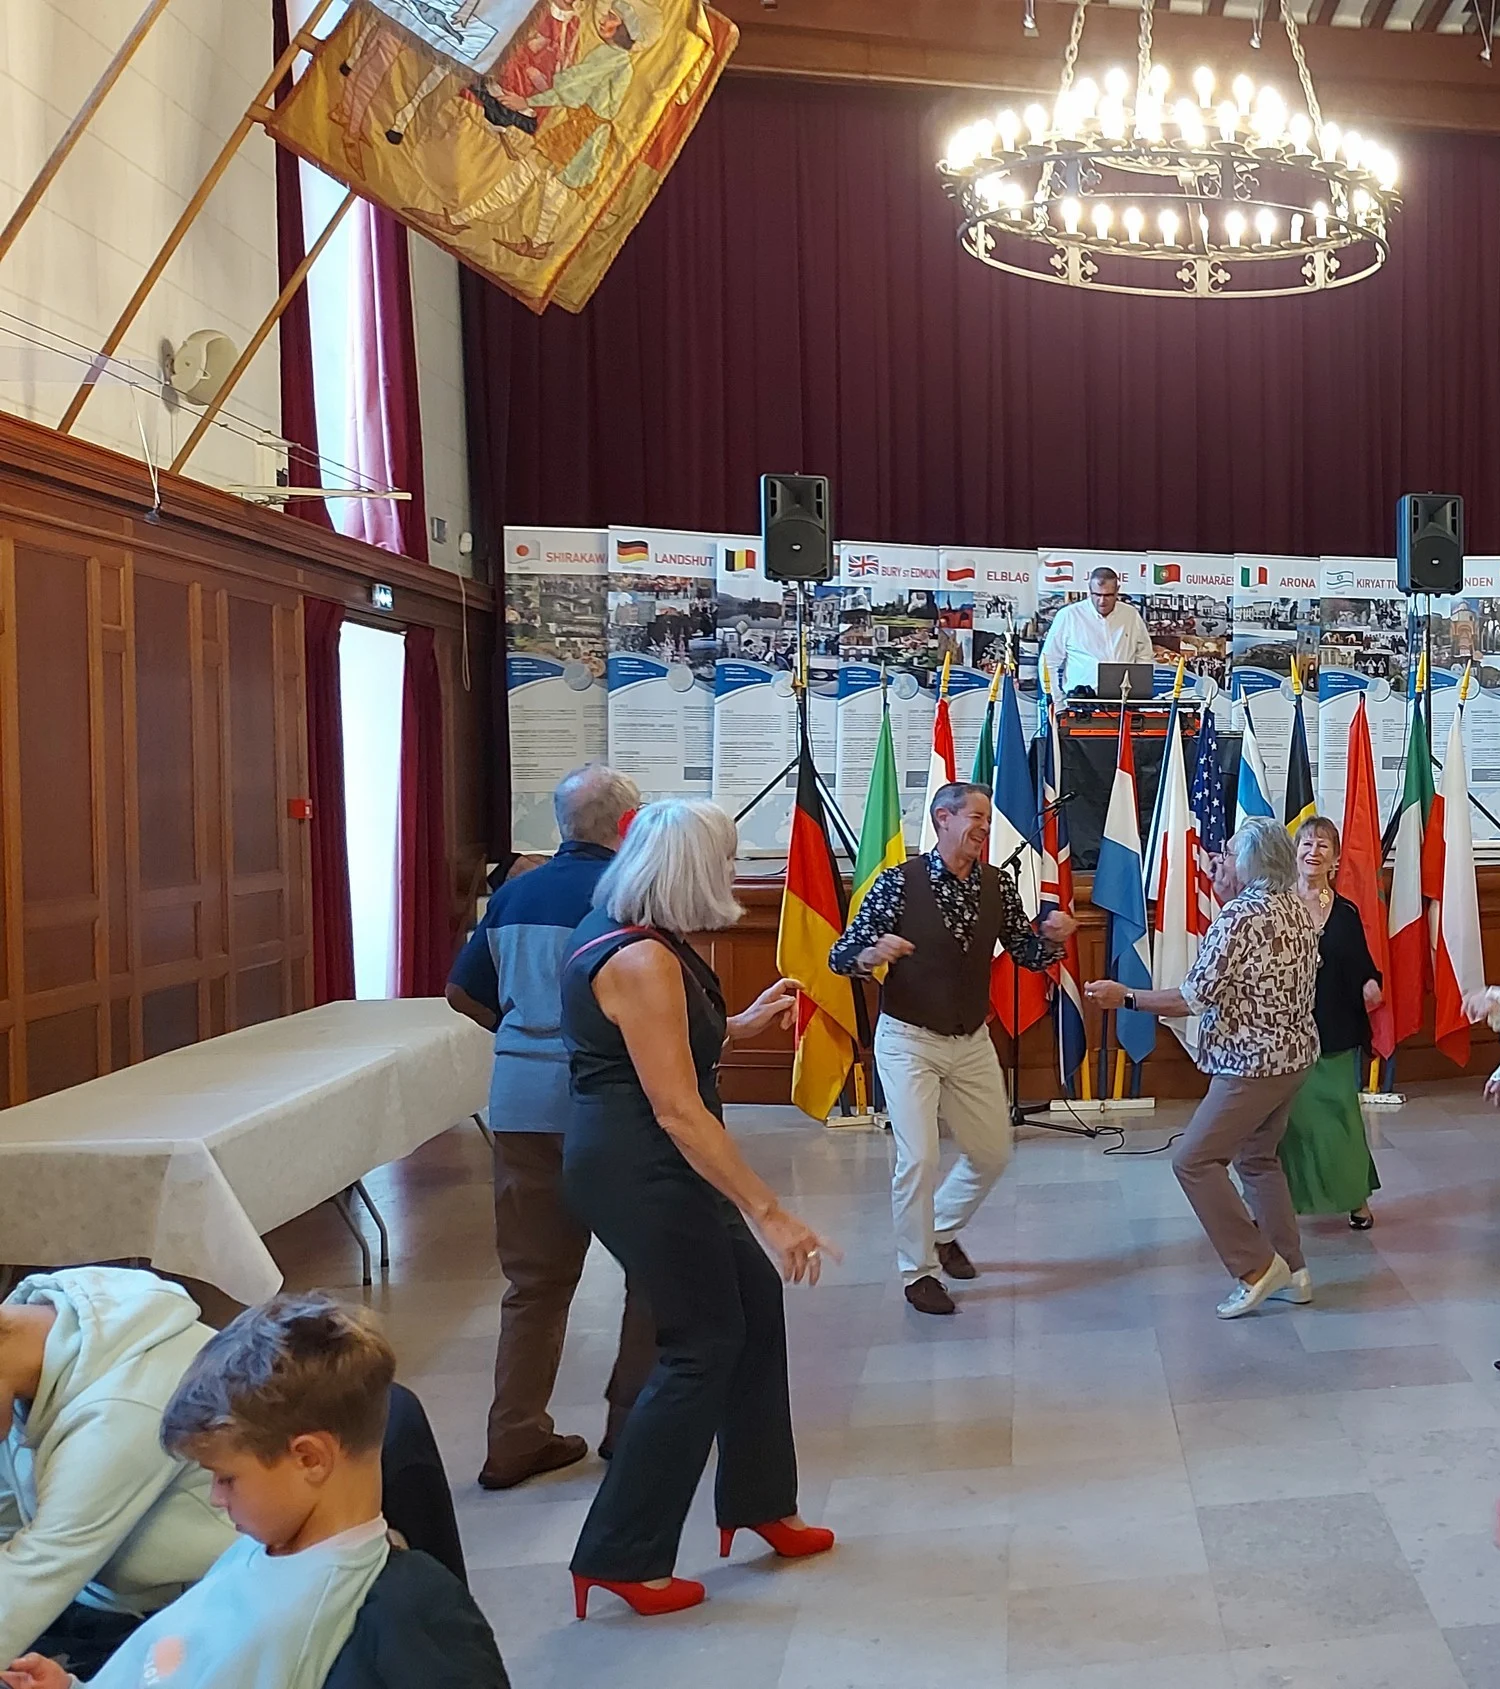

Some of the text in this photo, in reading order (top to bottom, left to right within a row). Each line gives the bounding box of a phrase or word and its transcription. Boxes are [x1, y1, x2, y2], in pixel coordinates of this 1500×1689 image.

[655, 552, 714, 567] LANDSHUT
[881, 565, 901, 577] BURY
[910, 567, 940, 579] EDMUN
[1279, 577, 1316, 588] ARONA
[1356, 578, 1385, 589] KIRYAT
[1464, 577, 1494, 587] NDEN
